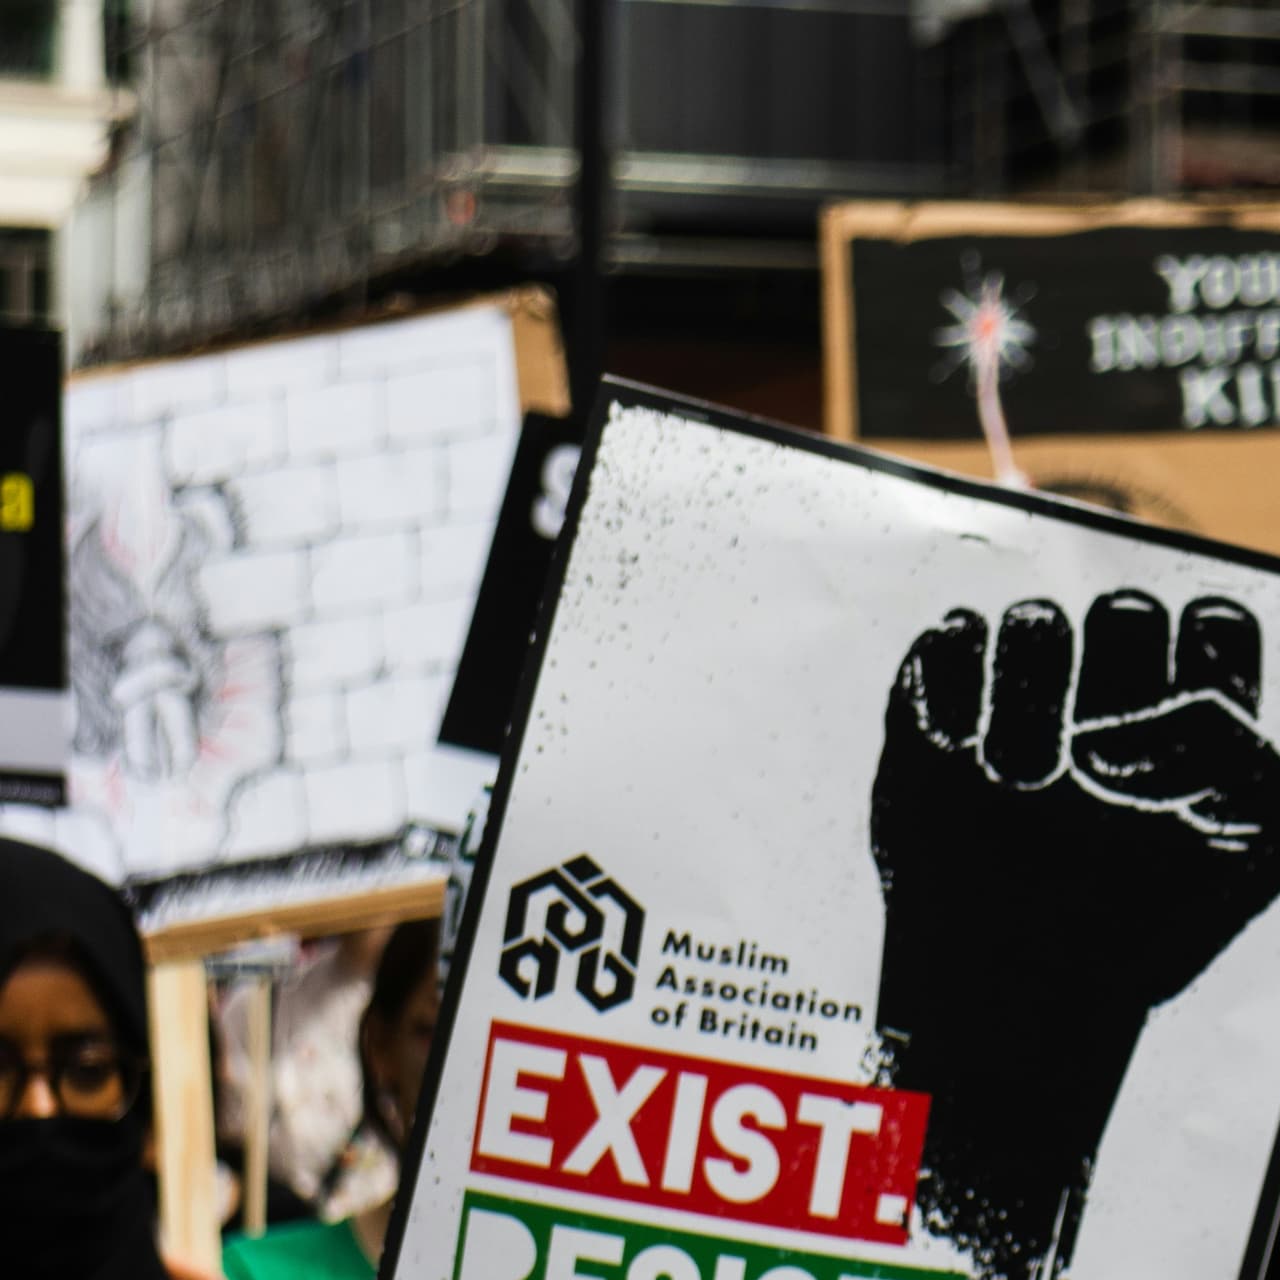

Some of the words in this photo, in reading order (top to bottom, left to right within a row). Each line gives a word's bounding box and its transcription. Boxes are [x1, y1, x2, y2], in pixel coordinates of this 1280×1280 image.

[661, 928, 790, 976] Muslim
[655, 965, 863, 1024] Association
[650, 1001, 690, 1030] of
[699, 1007, 819, 1053] Britain
[477, 1037, 910, 1228] EXIST.
